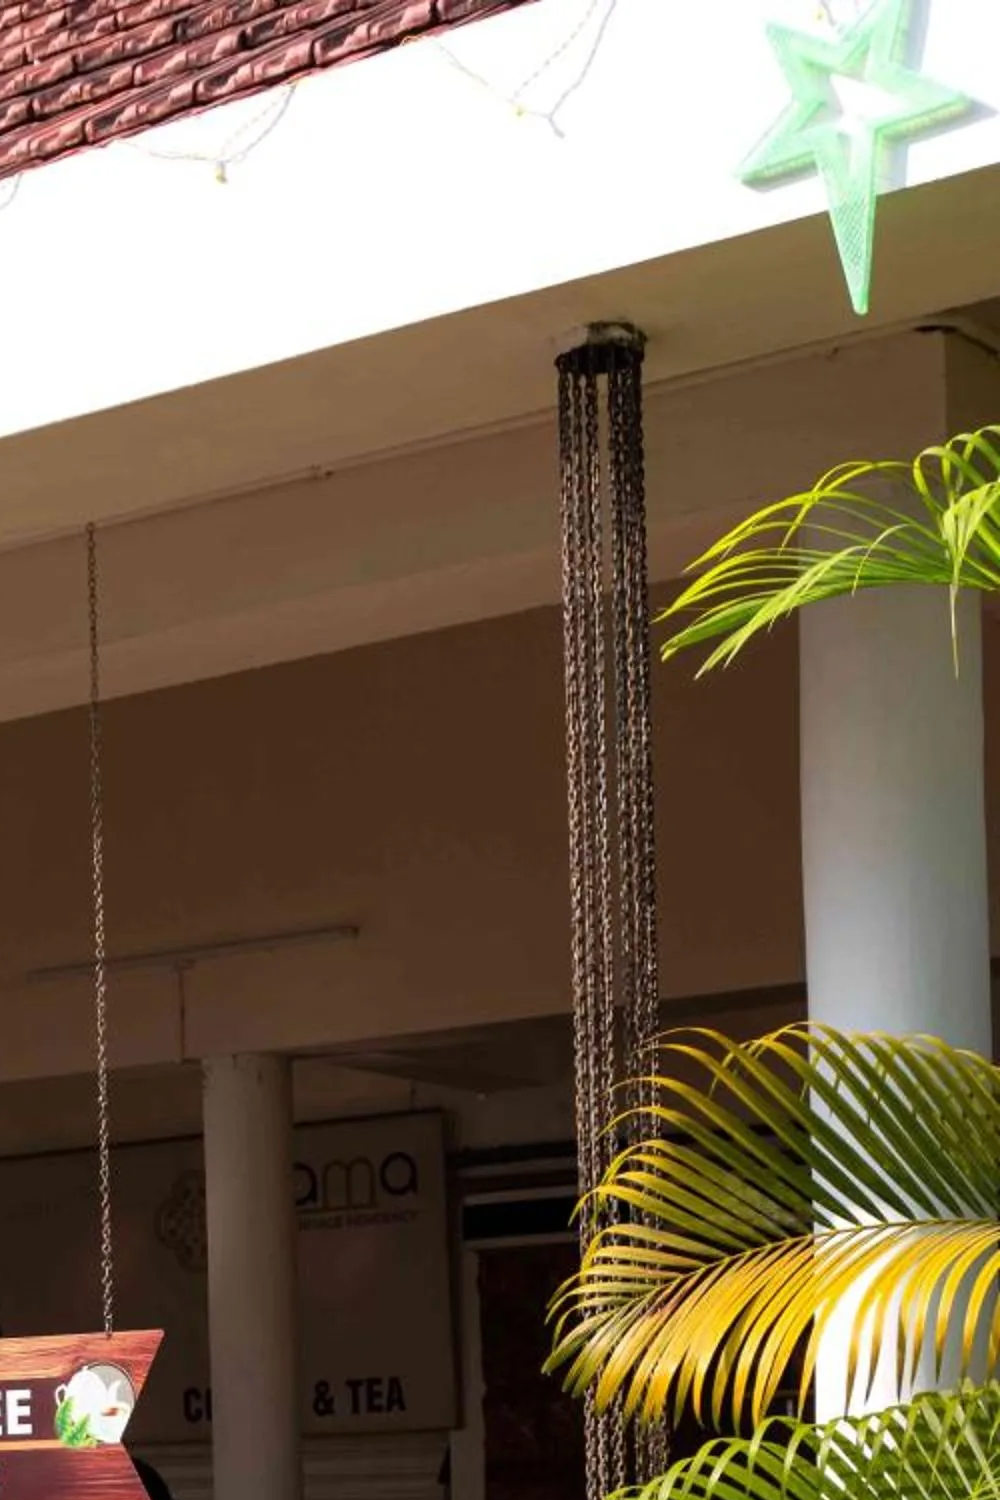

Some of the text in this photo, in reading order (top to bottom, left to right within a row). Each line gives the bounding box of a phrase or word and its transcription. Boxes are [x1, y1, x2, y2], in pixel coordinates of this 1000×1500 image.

[294, 1151, 418, 1211] ama
[313, 1376, 407, 1416] & TEA
